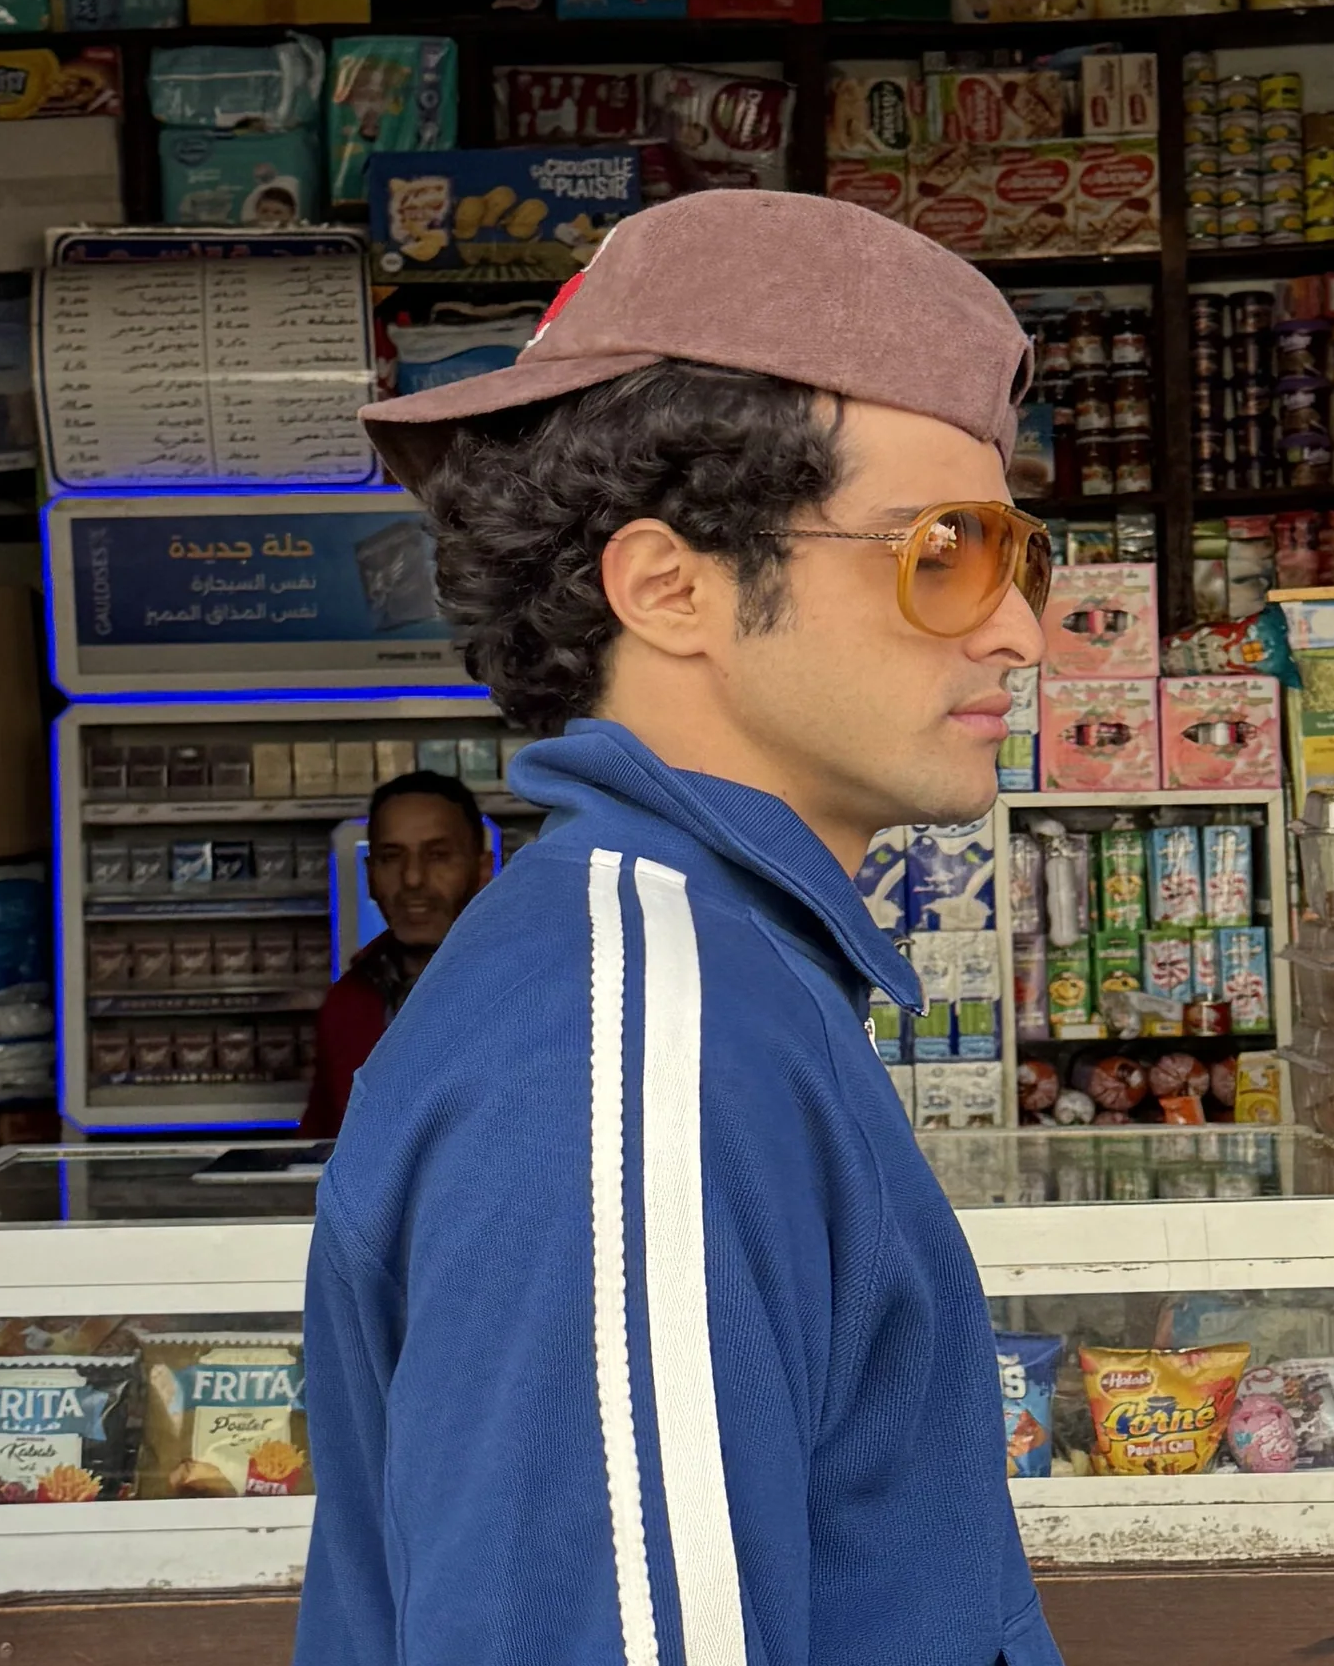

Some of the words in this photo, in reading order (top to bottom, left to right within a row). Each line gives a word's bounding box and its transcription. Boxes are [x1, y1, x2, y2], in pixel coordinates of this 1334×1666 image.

[169, 533, 253, 565] جديدة
[262, 531, 315, 560] حلة
[90, 545, 114, 636] GAULOISES
[270, 573, 317, 593] نفس
[272, 603, 318, 624] نفس
[192, 1369, 296, 1403] FRITA
[209, 1415, 274, 1435] Poulet
[1102, 1395, 1217, 1442] Corné
